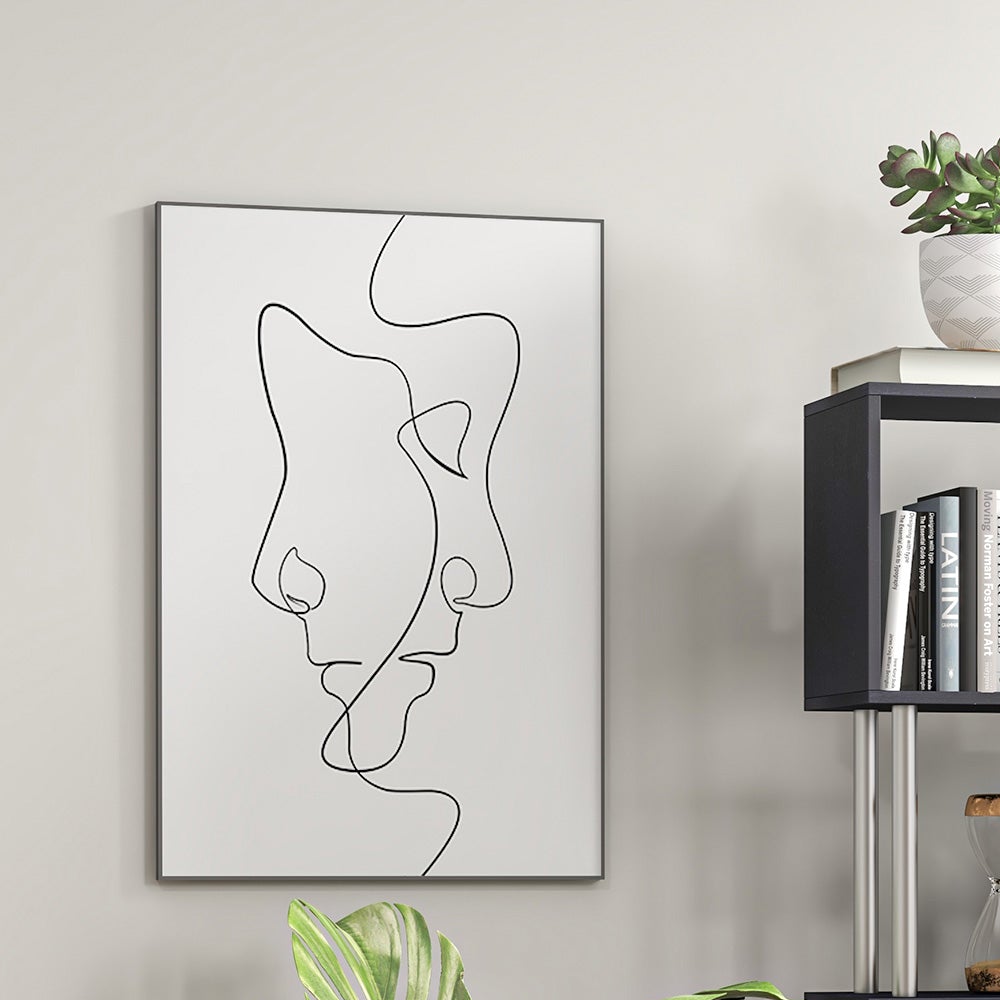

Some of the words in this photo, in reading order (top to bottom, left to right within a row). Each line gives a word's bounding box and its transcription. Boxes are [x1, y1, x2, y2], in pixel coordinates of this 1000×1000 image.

[981, 491, 993, 531] Moving
[984, 535, 994, 579] Norman
[893, 565, 901, 590] Typography
[941, 532, 959, 620] LATIN
[984, 584, 994, 618] Foster
[984, 622, 991, 635] on
[984, 639, 994, 656] Art
